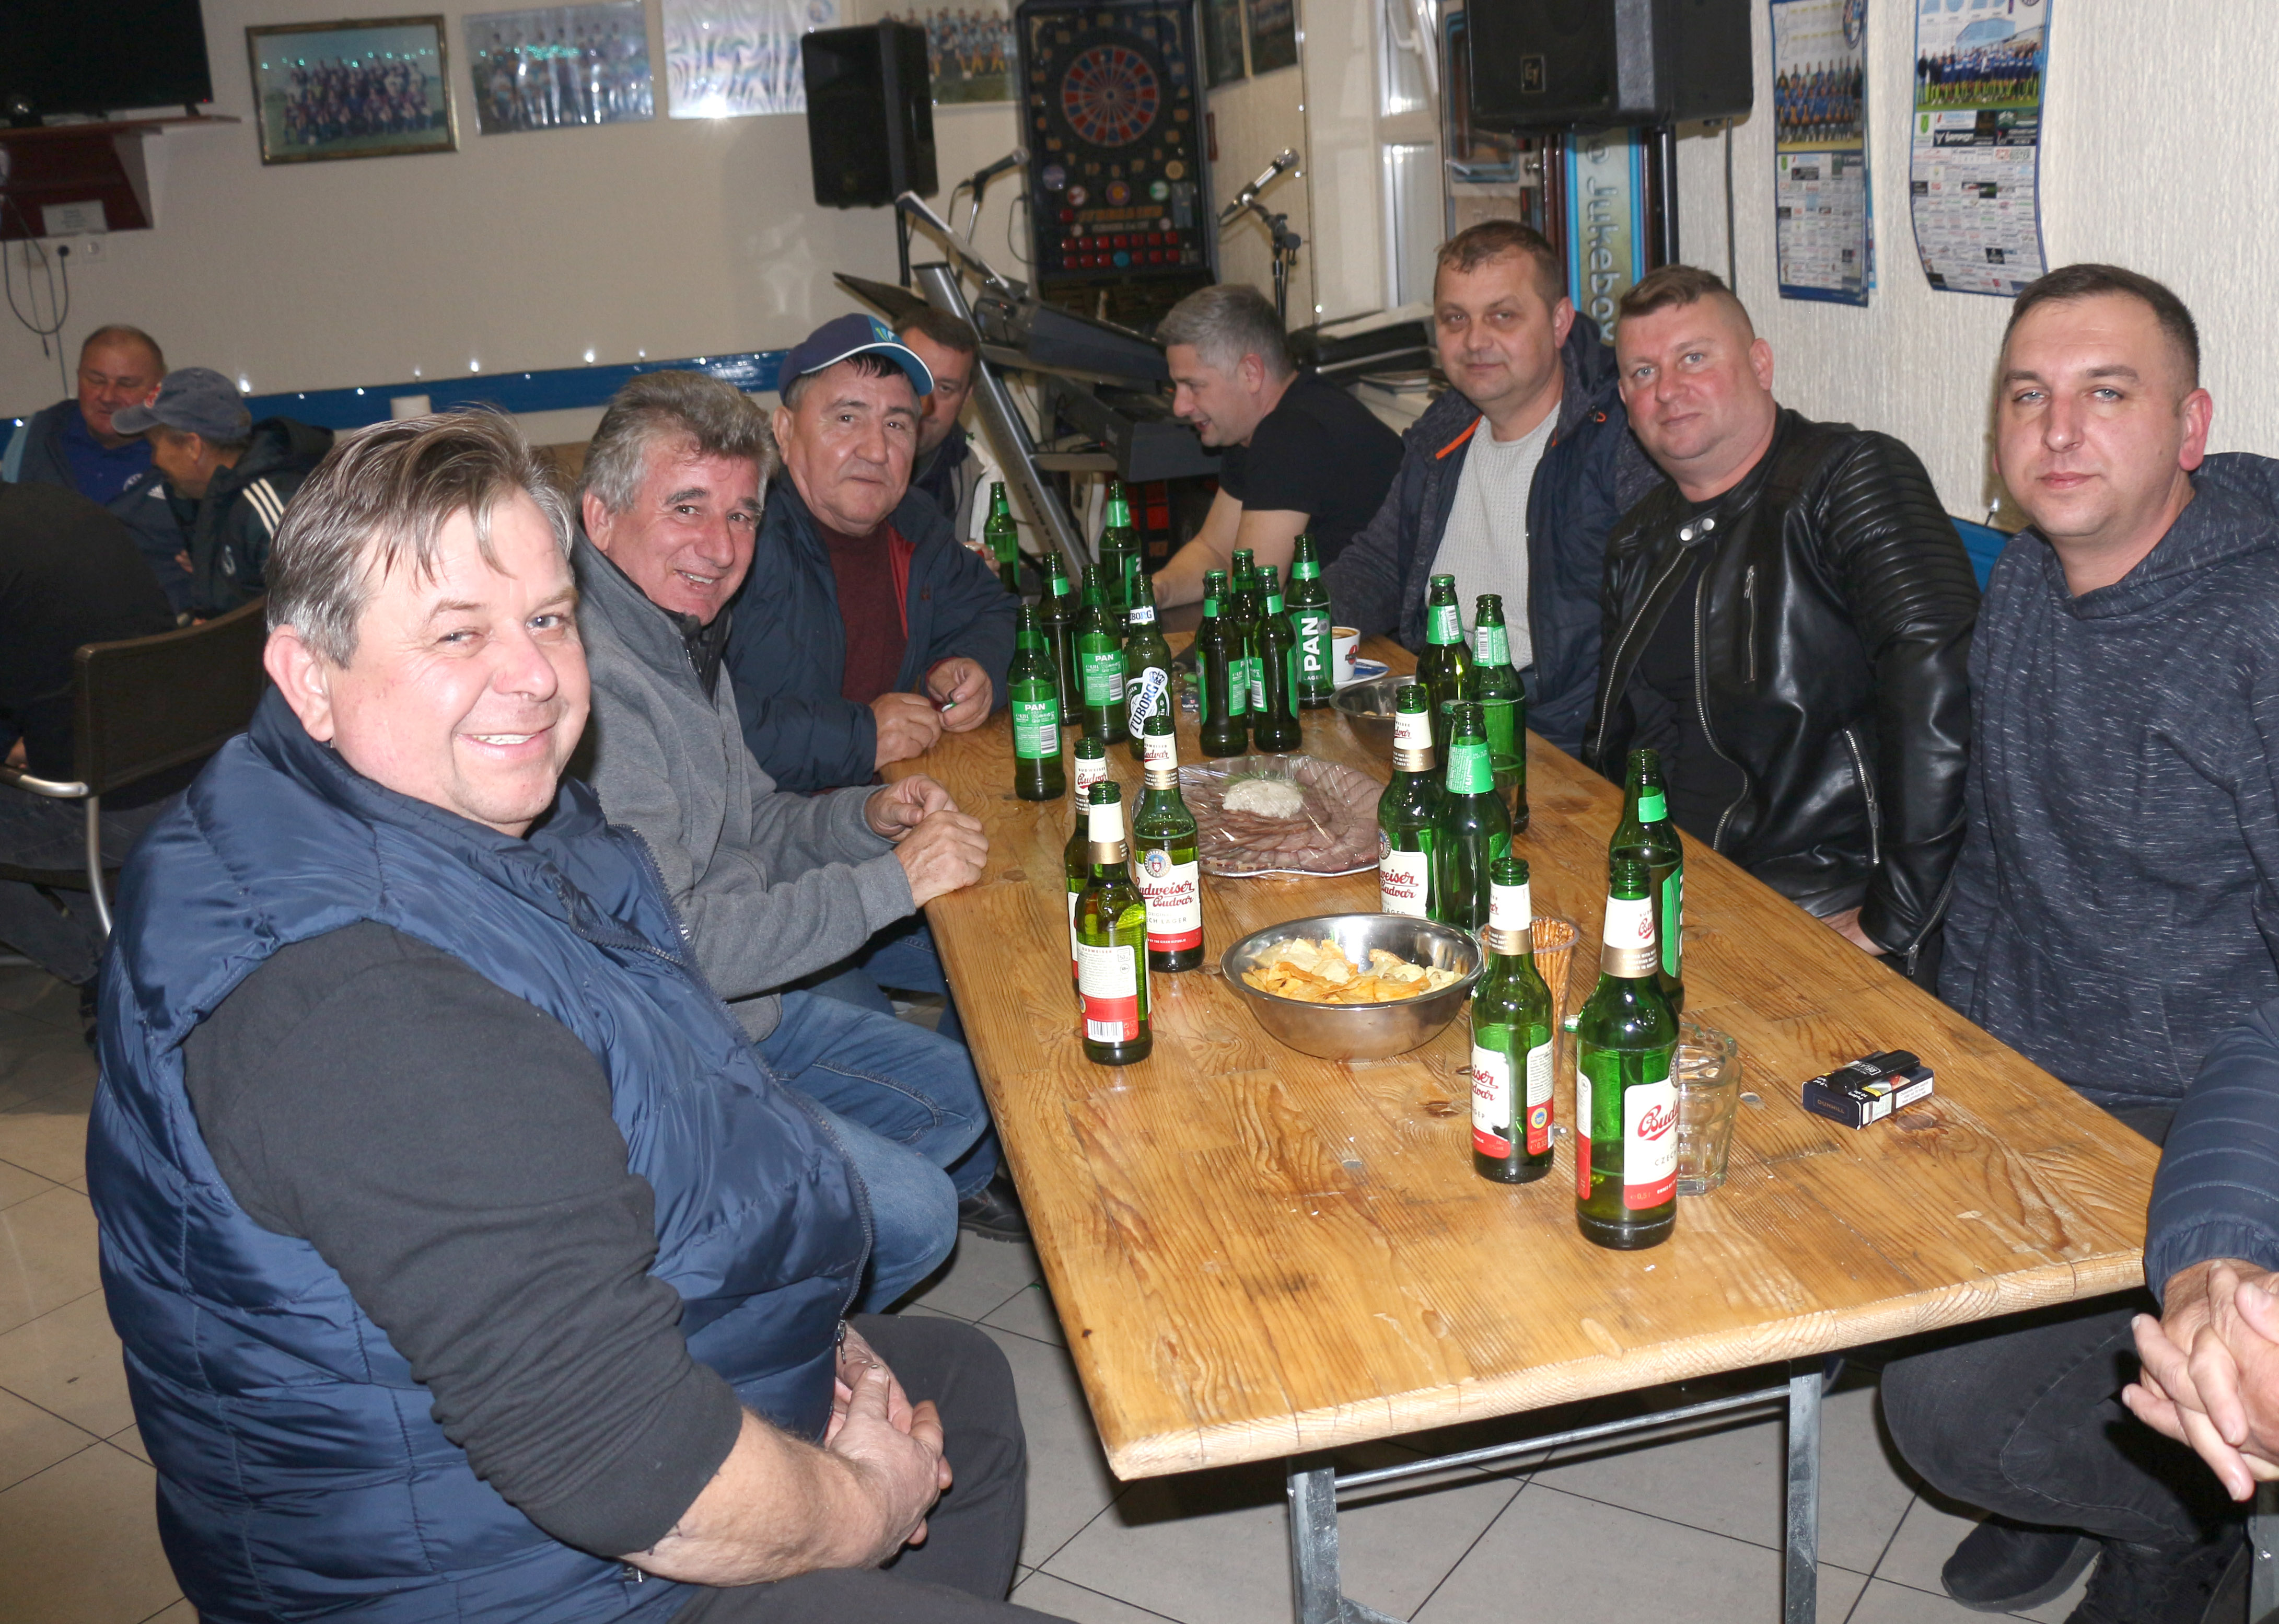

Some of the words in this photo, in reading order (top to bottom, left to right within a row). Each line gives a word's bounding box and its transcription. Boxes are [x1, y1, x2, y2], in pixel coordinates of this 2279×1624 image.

[1586, 176, 1620, 341] Jukebox
[1130, 610, 1152, 621] UBORG
[1301, 617, 1321, 671] PAN
[1095, 654, 1114, 662] PAN
[1025, 703, 1045, 711] PAN
[1130, 683, 1159, 733] TUBORG
[1395, 726, 1412, 738] dvar
[1380, 869, 1419, 887] weiser
[1153, 895, 1194, 907] Budvar
[1472, 1083, 1496, 1101] dvar
[1817, 1099, 1845, 1114] DUNHILL
[1637, 1192, 1647, 1200] 0,5
